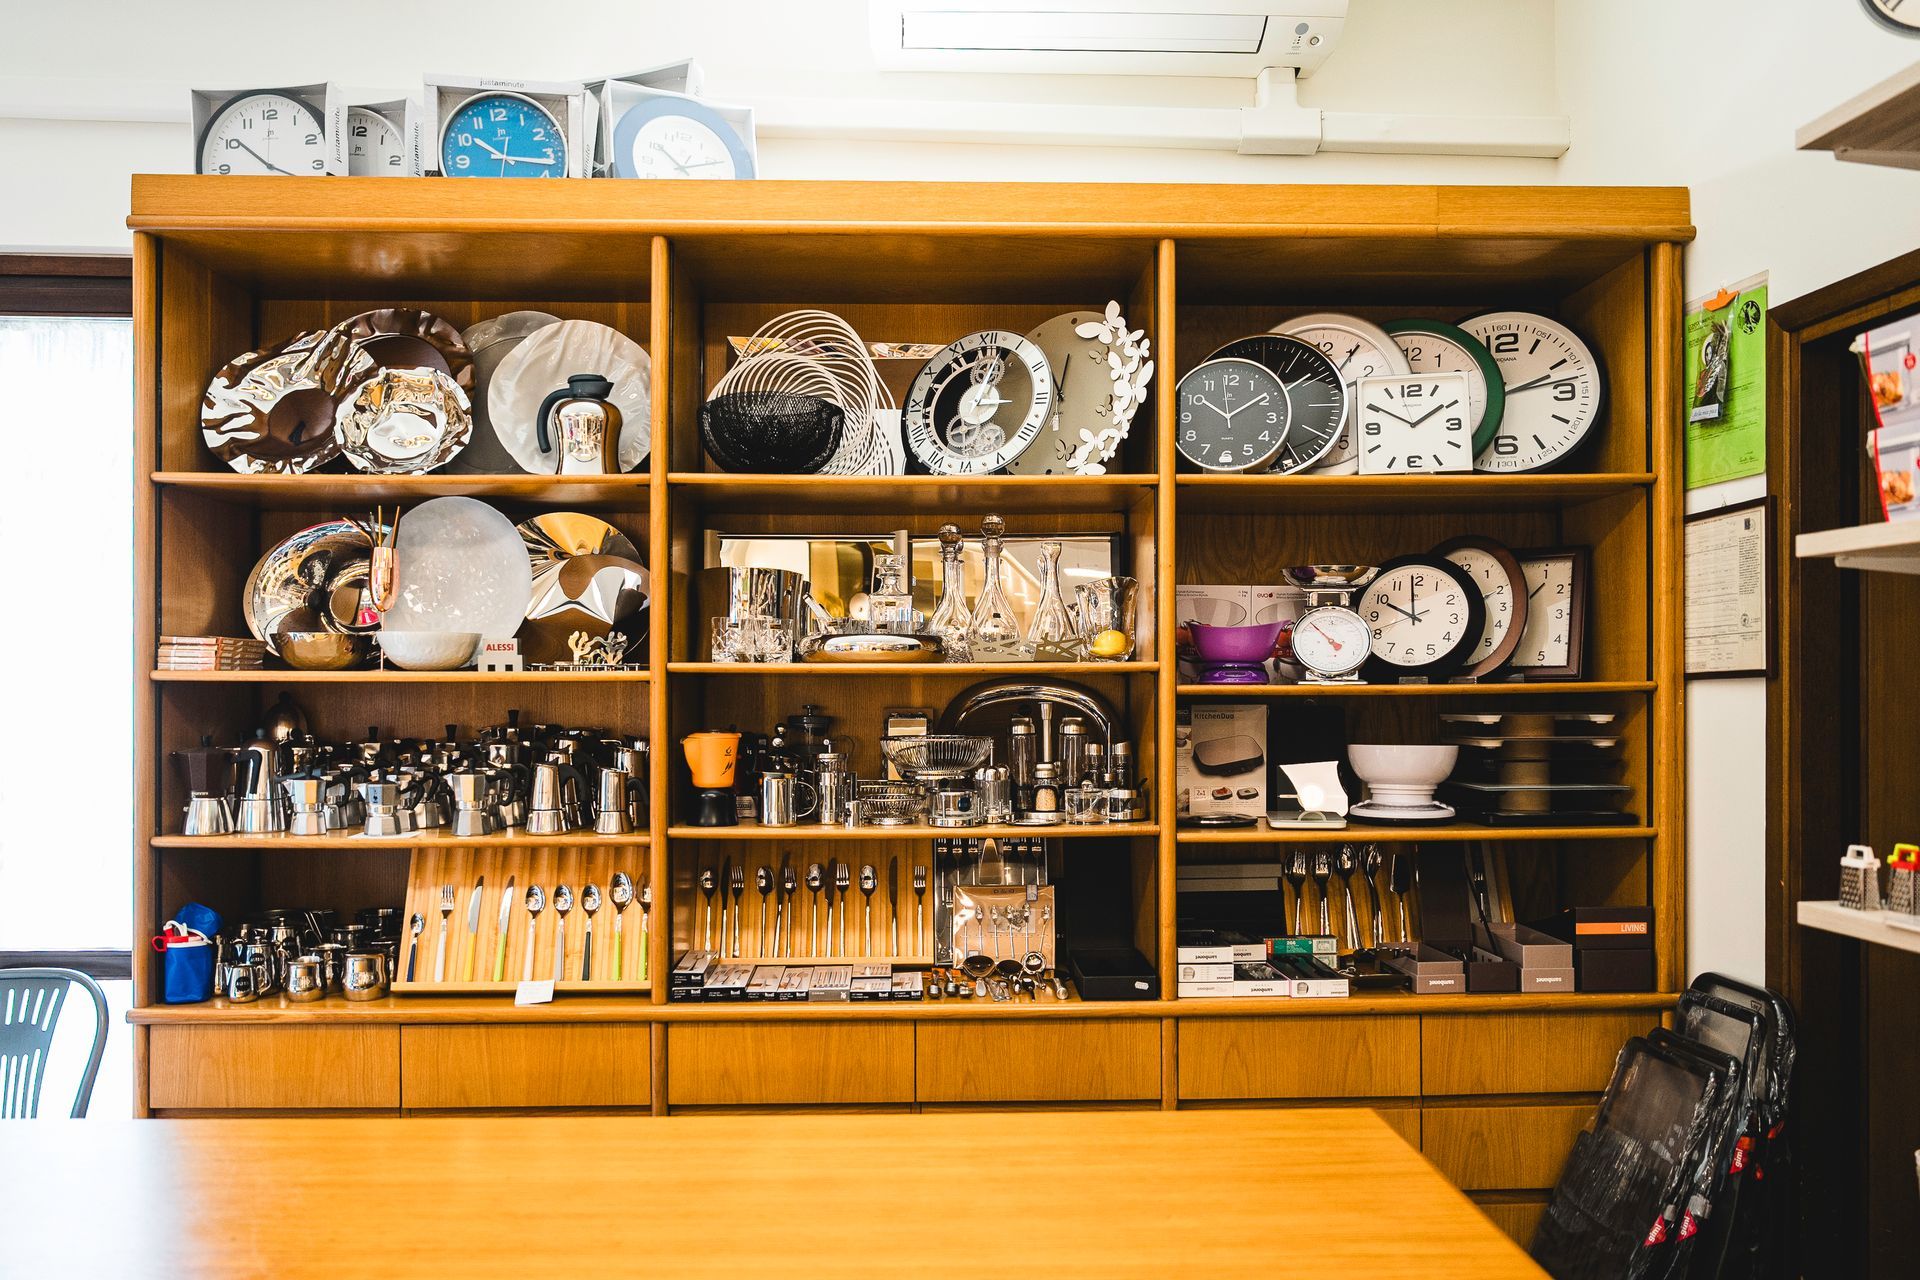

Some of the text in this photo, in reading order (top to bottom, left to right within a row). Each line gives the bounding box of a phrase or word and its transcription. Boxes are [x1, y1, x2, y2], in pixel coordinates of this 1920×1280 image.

[480, 78, 524, 89] justaminute
[262, 109, 278, 121] 12
[490, 108, 507, 121] 12
[519, 113, 525, 126] 1
[242, 118, 253, 130] 11
[473, 117, 484, 129] 11
[352, 125, 368, 137] 12
[532, 128, 546, 141] 2
[225, 138, 241, 150] 10
[305, 134, 317, 145] 2
[380, 134, 385, 146] 1
[458, 133, 473, 147] 10
[312, 160, 325, 170] 3
[389, 155, 402, 166] 2
[455, 155, 471, 168] 9
[218, 164, 231, 175] 9
[1496, 324, 1508, 332] 60
[1535, 327, 1548, 339] 05
[979, 332, 998, 345] XII
[1485, 332, 1520, 354] 12
[949, 341, 965, 358] XI
[1434, 353, 1442, 368] 1
[1567, 351, 1577, 361] 10
[924, 366, 938, 379] X
[1031, 361, 1045, 373] II
[1203, 380, 1215, 392] 11
[1224, 374, 1240, 387] 12
[1249, 380, 1254, 391] 1
[1401, 384, 1423, 398] 12
[1552, 382, 1576, 402] 3
[1581, 385, 1589, 395] 15
[1034, 391, 1049, 405] III
[1187, 394, 1206, 406] 10
[909, 398, 924, 413] IX
[1181, 412, 1193, 424] 9
[1266, 412, 1278, 424] 3
[1445, 417, 1462, 431] 3
[1365, 422, 1381, 436] 9
[1570, 420, 1581, 431] 20
[1185, 429, 1197, 442] 8
[1257, 430, 1271, 442] 4
[1338, 435, 1350, 450] 5
[1493, 434, 1519, 456] 6
[1200, 443, 1211, 456] 7
[1242, 444, 1254, 456] 5
[1541, 447, 1553, 458] 25
[996, 452, 1006, 465] V
[1501, 460, 1513, 468] 30
[1484, 569, 1490, 579] 1
[1543, 569, 1548, 579] 1
[1392, 580, 1402, 592] 11
[1434, 580, 1439, 592] 1
[1496, 585, 1504, 595] 2
[1556, 584, 1564, 594] 2
[1376, 593, 1389, 605] 10
[1445, 594, 1455, 606] 2
[1499, 602, 1508, 612] 3
[1369, 611, 1379, 623] 9
[1448, 612, 1459, 624] 3
[1555, 608, 1563, 619] 3
[1494, 619, 1503, 629] 4
[1373, 628, 1382, 640] 8
[1442, 631, 1452, 643] 4
[1553, 634, 1562, 644] 4
[485, 643, 514, 652] ALESSI
[1386, 642, 1396, 654] 7
[1484, 637, 1492, 647] 5
[1426, 643, 1436, 656] 5
[1537, 650, 1546, 662] 5
[1620, 923, 1646, 932] LIVING
